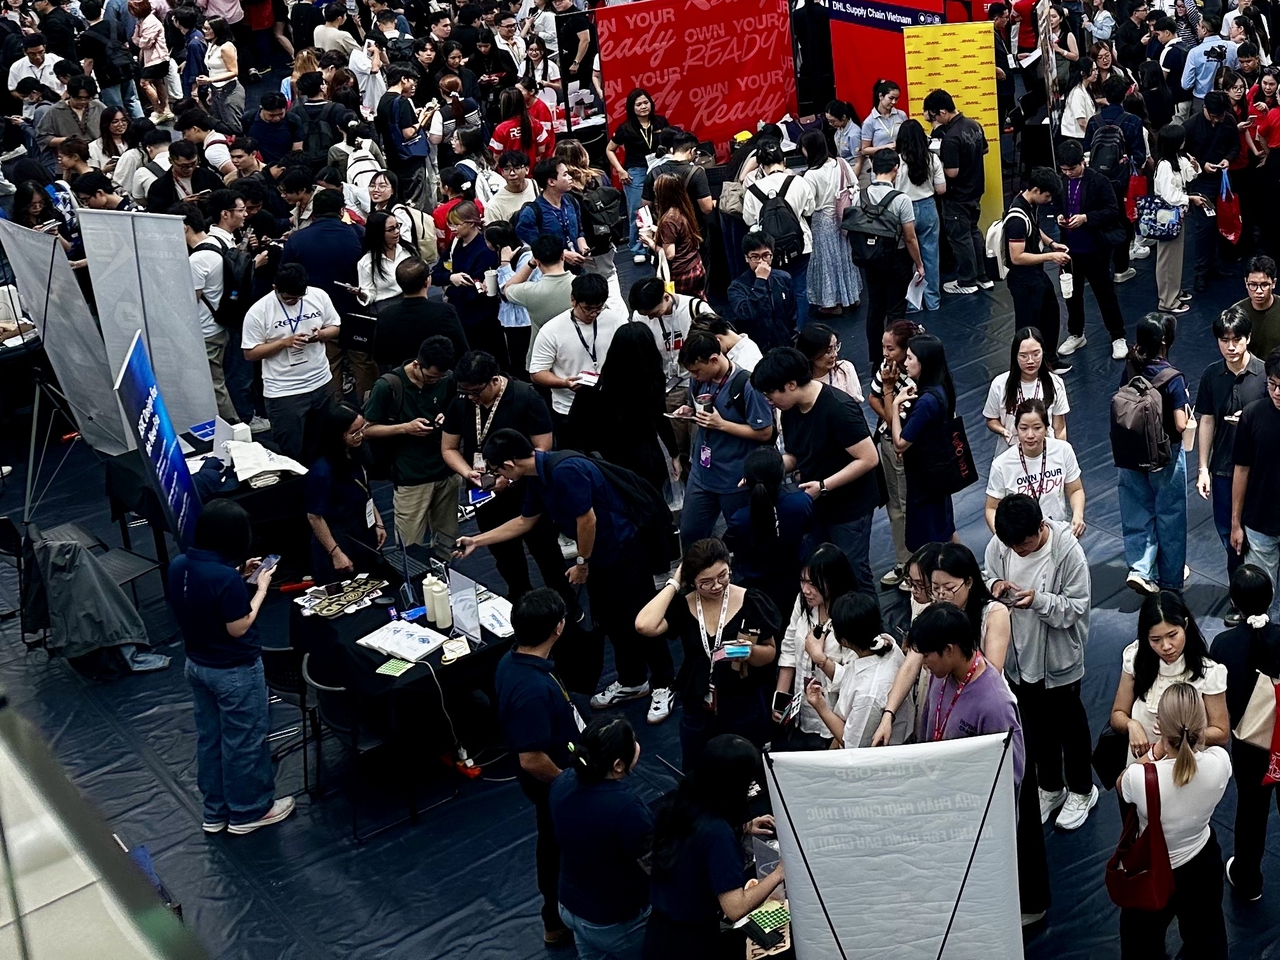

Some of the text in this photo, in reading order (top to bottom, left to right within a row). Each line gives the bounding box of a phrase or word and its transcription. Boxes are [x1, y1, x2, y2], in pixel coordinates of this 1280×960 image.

[625, 8, 675, 30] YOUR
[832, 1, 912, 24] DHL Supply Chain Vietnam
[684, 23, 725, 43] OWN
[732, 13, 779, 33] YOUR
[683, 28, 779, 75] READY
[631, 66, 681, 88] YOUR
[689, 70, 784, 103] OWN YOUR
[274, 311, 321, 329] RENESAS
[1017, 468, 1063, 486] OWN YOUR
